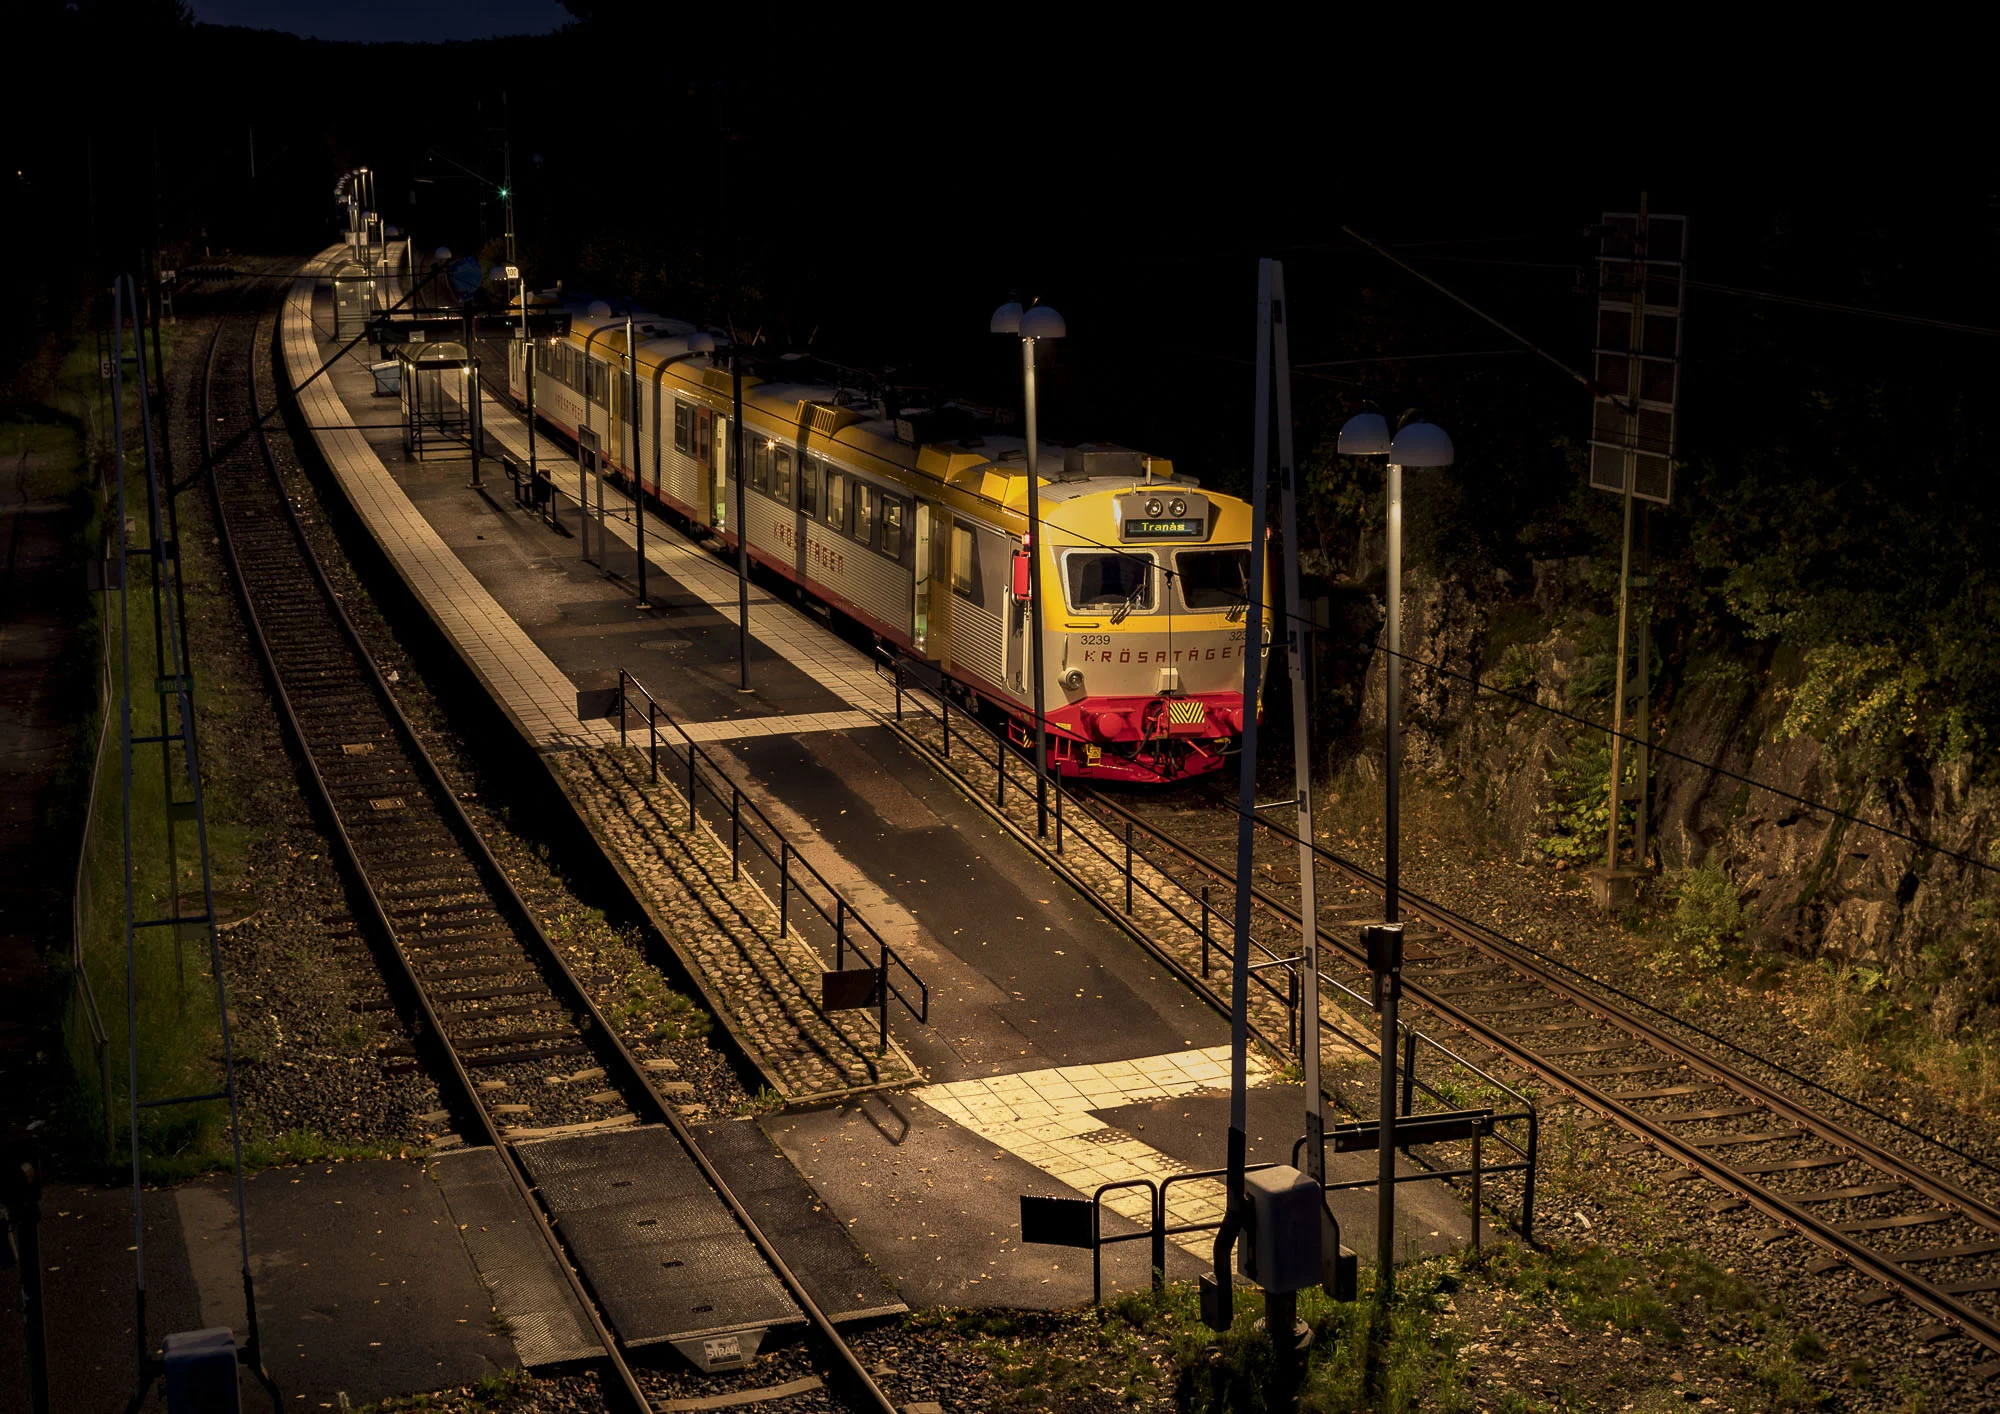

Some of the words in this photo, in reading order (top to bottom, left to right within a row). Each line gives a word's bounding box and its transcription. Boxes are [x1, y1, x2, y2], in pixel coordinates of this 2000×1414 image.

[1141, 522, 1185, 531] Tranås
[1080, 635, 1111, 645] 3239
[1229, 631, 1248, 641] 323
[707, 1345, 740, 1357] STRAIL
